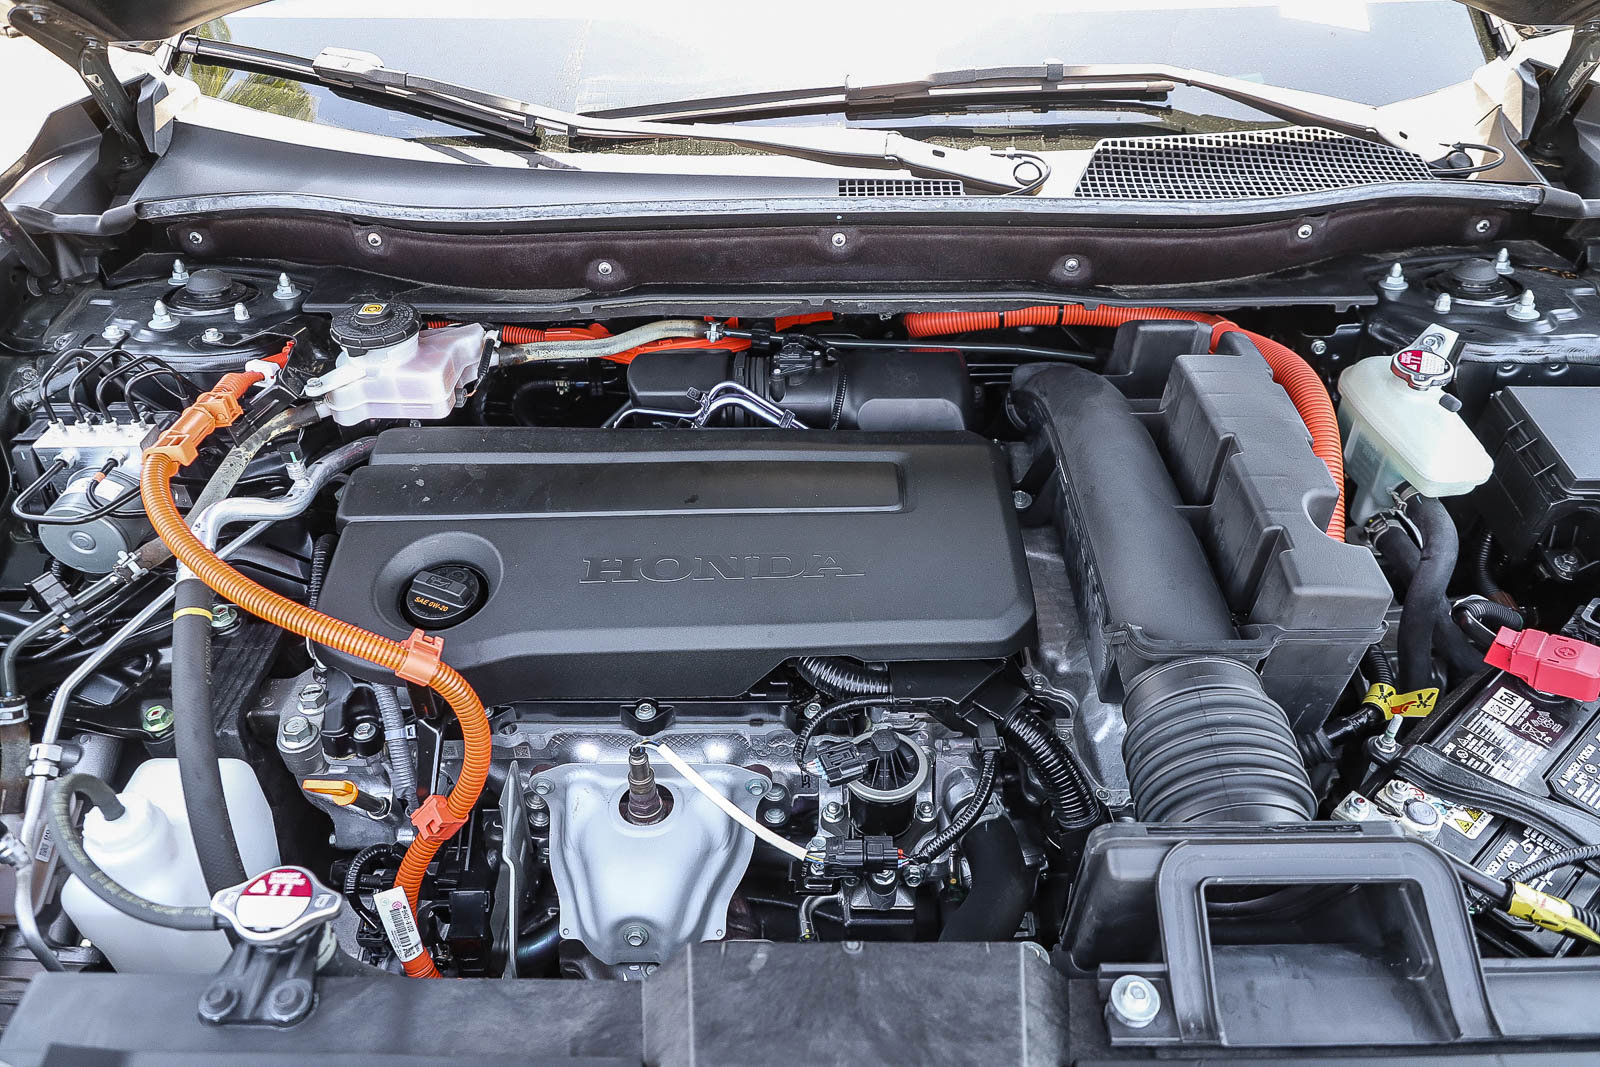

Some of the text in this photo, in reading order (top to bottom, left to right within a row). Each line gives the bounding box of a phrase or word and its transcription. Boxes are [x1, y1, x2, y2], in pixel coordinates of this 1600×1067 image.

[578, 553, 865, 584] HONDA
[414, 596, 449, 612] SAE 0W-20
